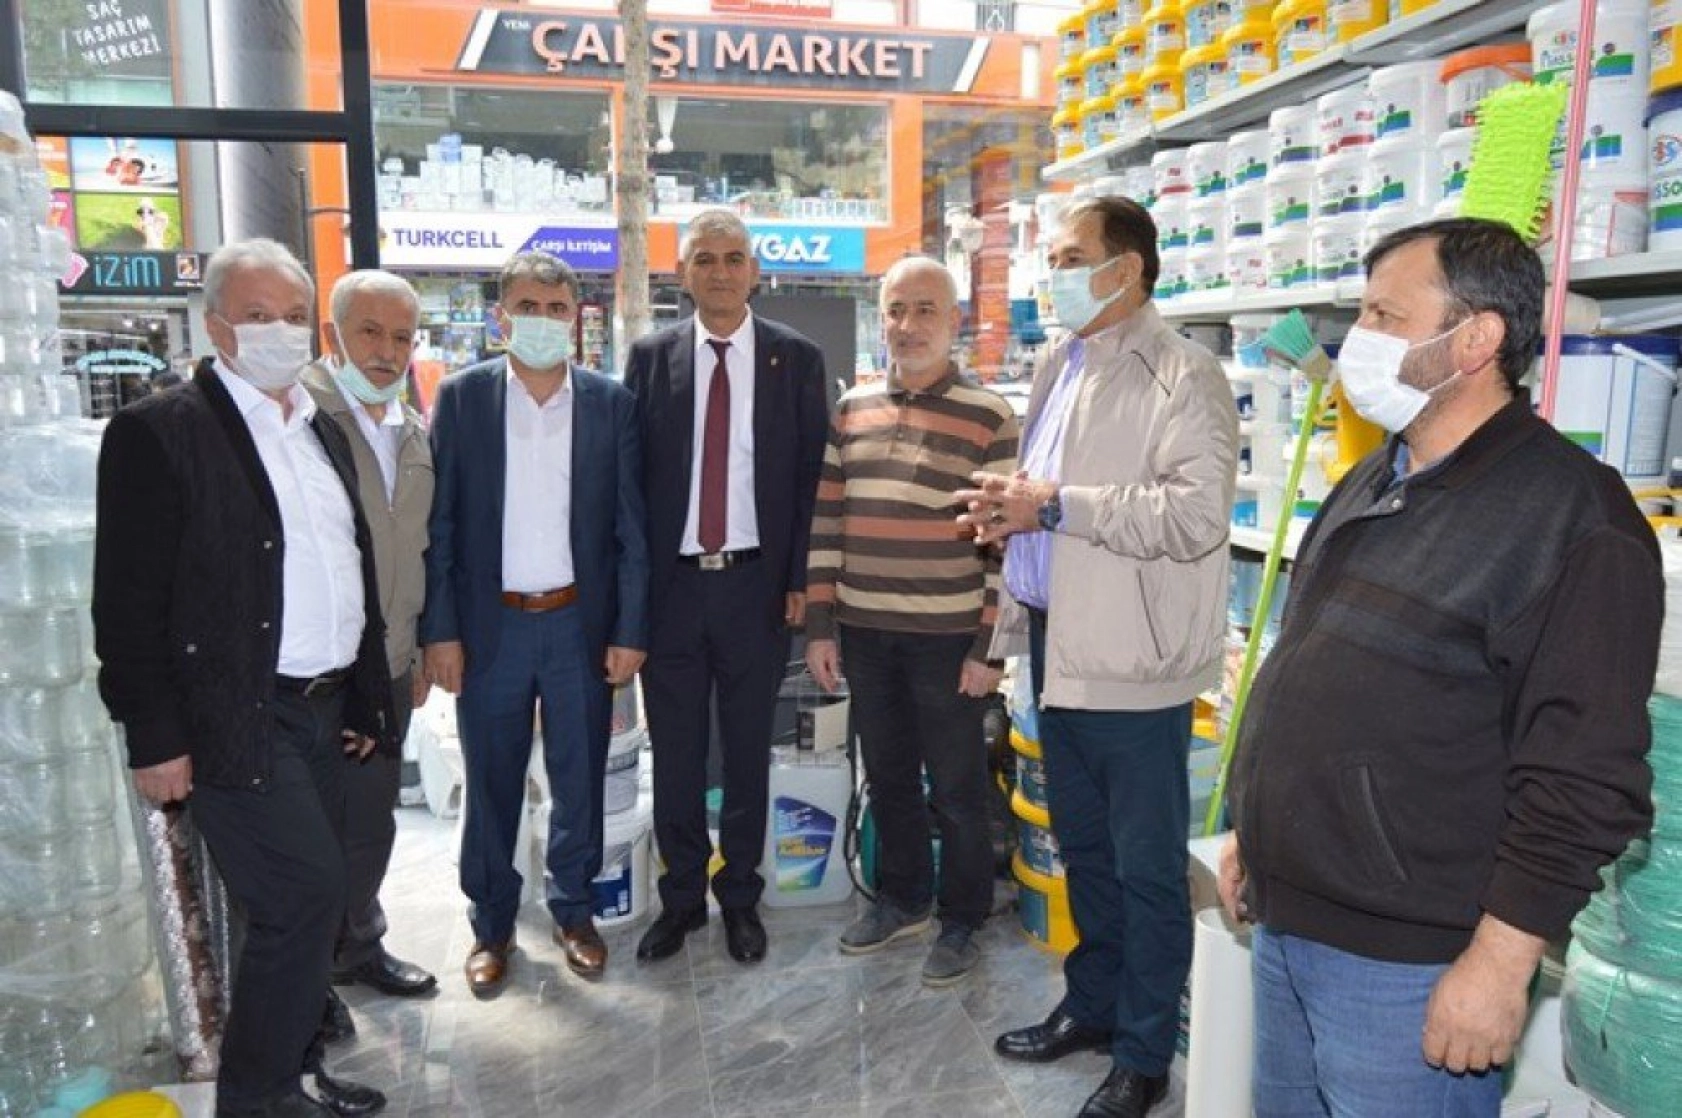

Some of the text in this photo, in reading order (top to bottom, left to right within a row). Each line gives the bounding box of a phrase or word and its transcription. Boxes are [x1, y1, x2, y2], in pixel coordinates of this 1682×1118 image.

[72, 14, 152, 46] TASARIM
[714, 30, 933, 78] MARKET
[391, 228, 504, 248] TURKCELL
